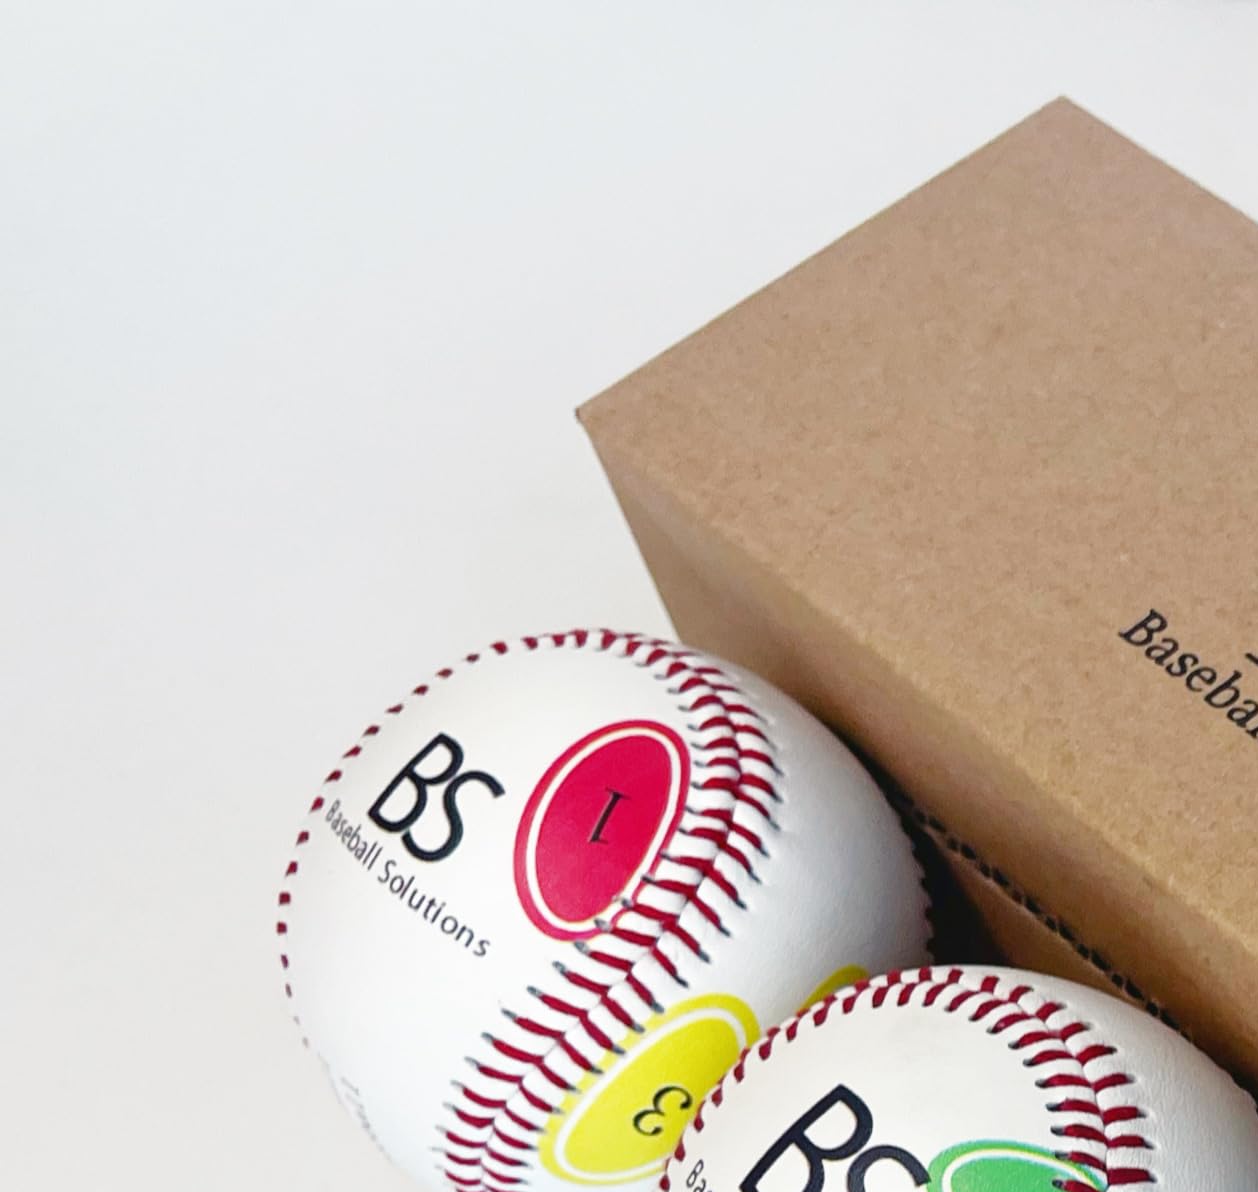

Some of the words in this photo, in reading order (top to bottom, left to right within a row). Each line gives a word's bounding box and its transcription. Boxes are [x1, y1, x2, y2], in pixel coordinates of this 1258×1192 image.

[368, 733, 505, 862] BS
[325, 799, 383, 871] Baseball
[377, 859, 491, 957] Solutions
